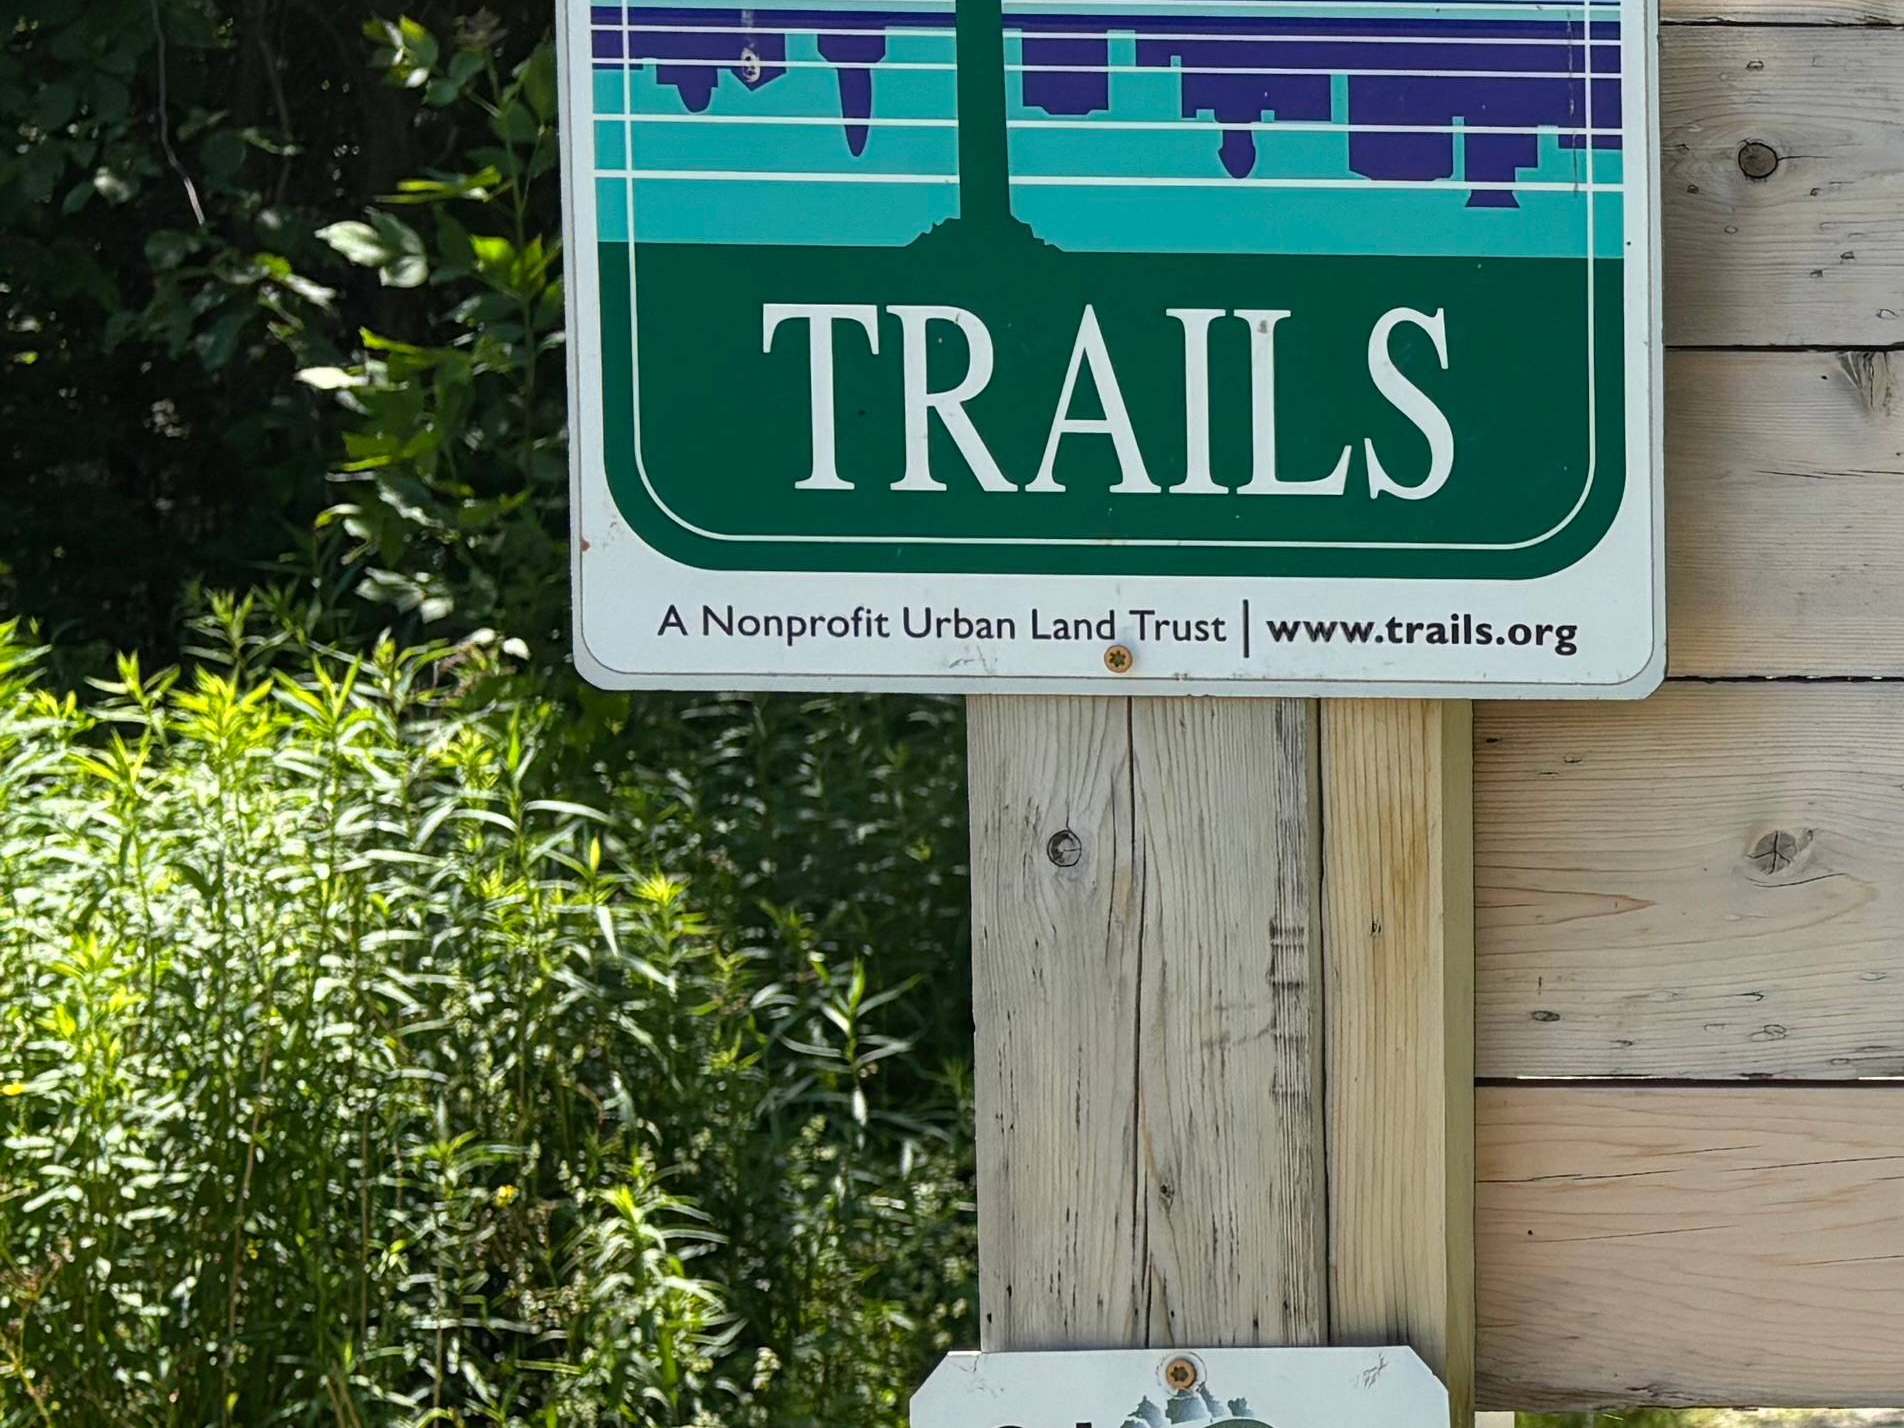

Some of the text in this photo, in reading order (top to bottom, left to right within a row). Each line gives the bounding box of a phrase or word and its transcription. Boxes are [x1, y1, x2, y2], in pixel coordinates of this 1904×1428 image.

[762, 303, 1455, 500] TRAILS
[657, 601, 1579, 658] A Nonprofit Urban Land Trust www.trails.org
